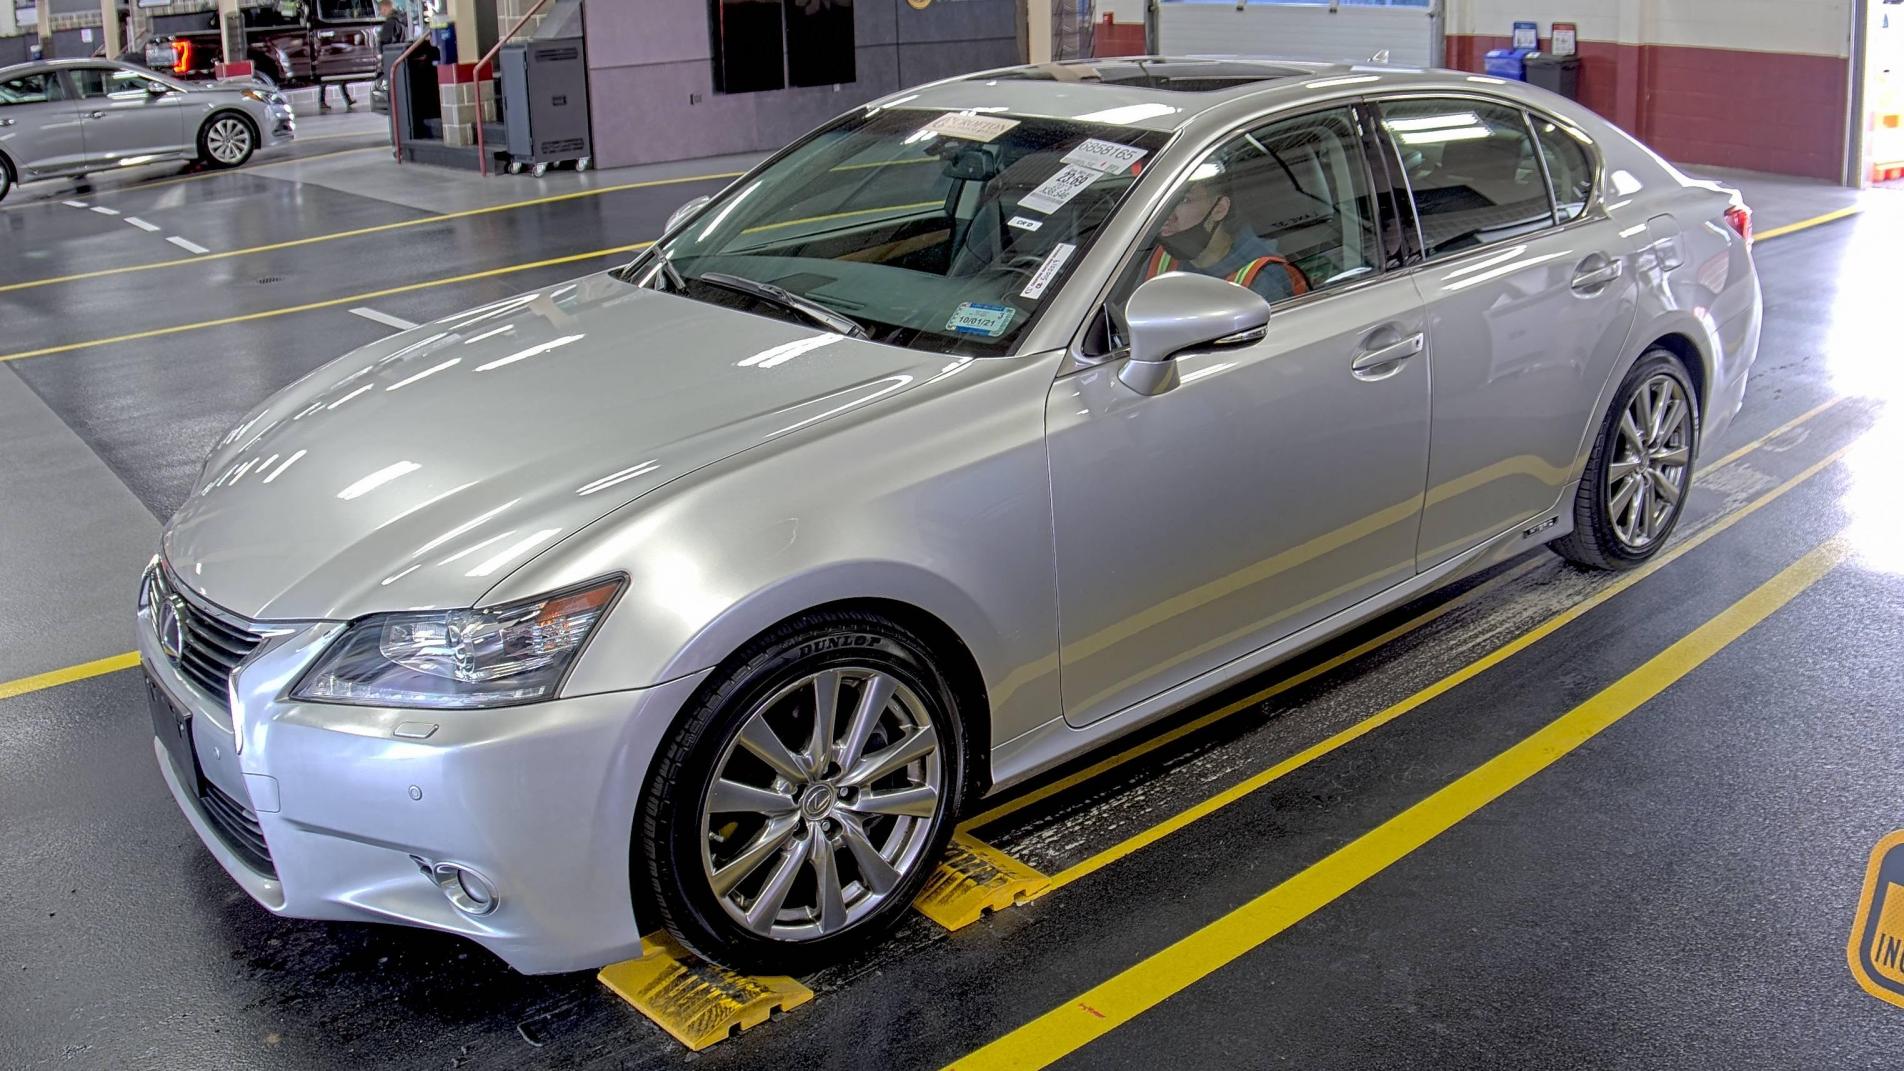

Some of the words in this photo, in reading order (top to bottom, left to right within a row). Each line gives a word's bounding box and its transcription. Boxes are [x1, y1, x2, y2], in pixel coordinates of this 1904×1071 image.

[960, 315, 995, 327] 10/01/21
[799, 634, 882, 657] DUNLOP
[1875, 933, 1904, 973] IN
